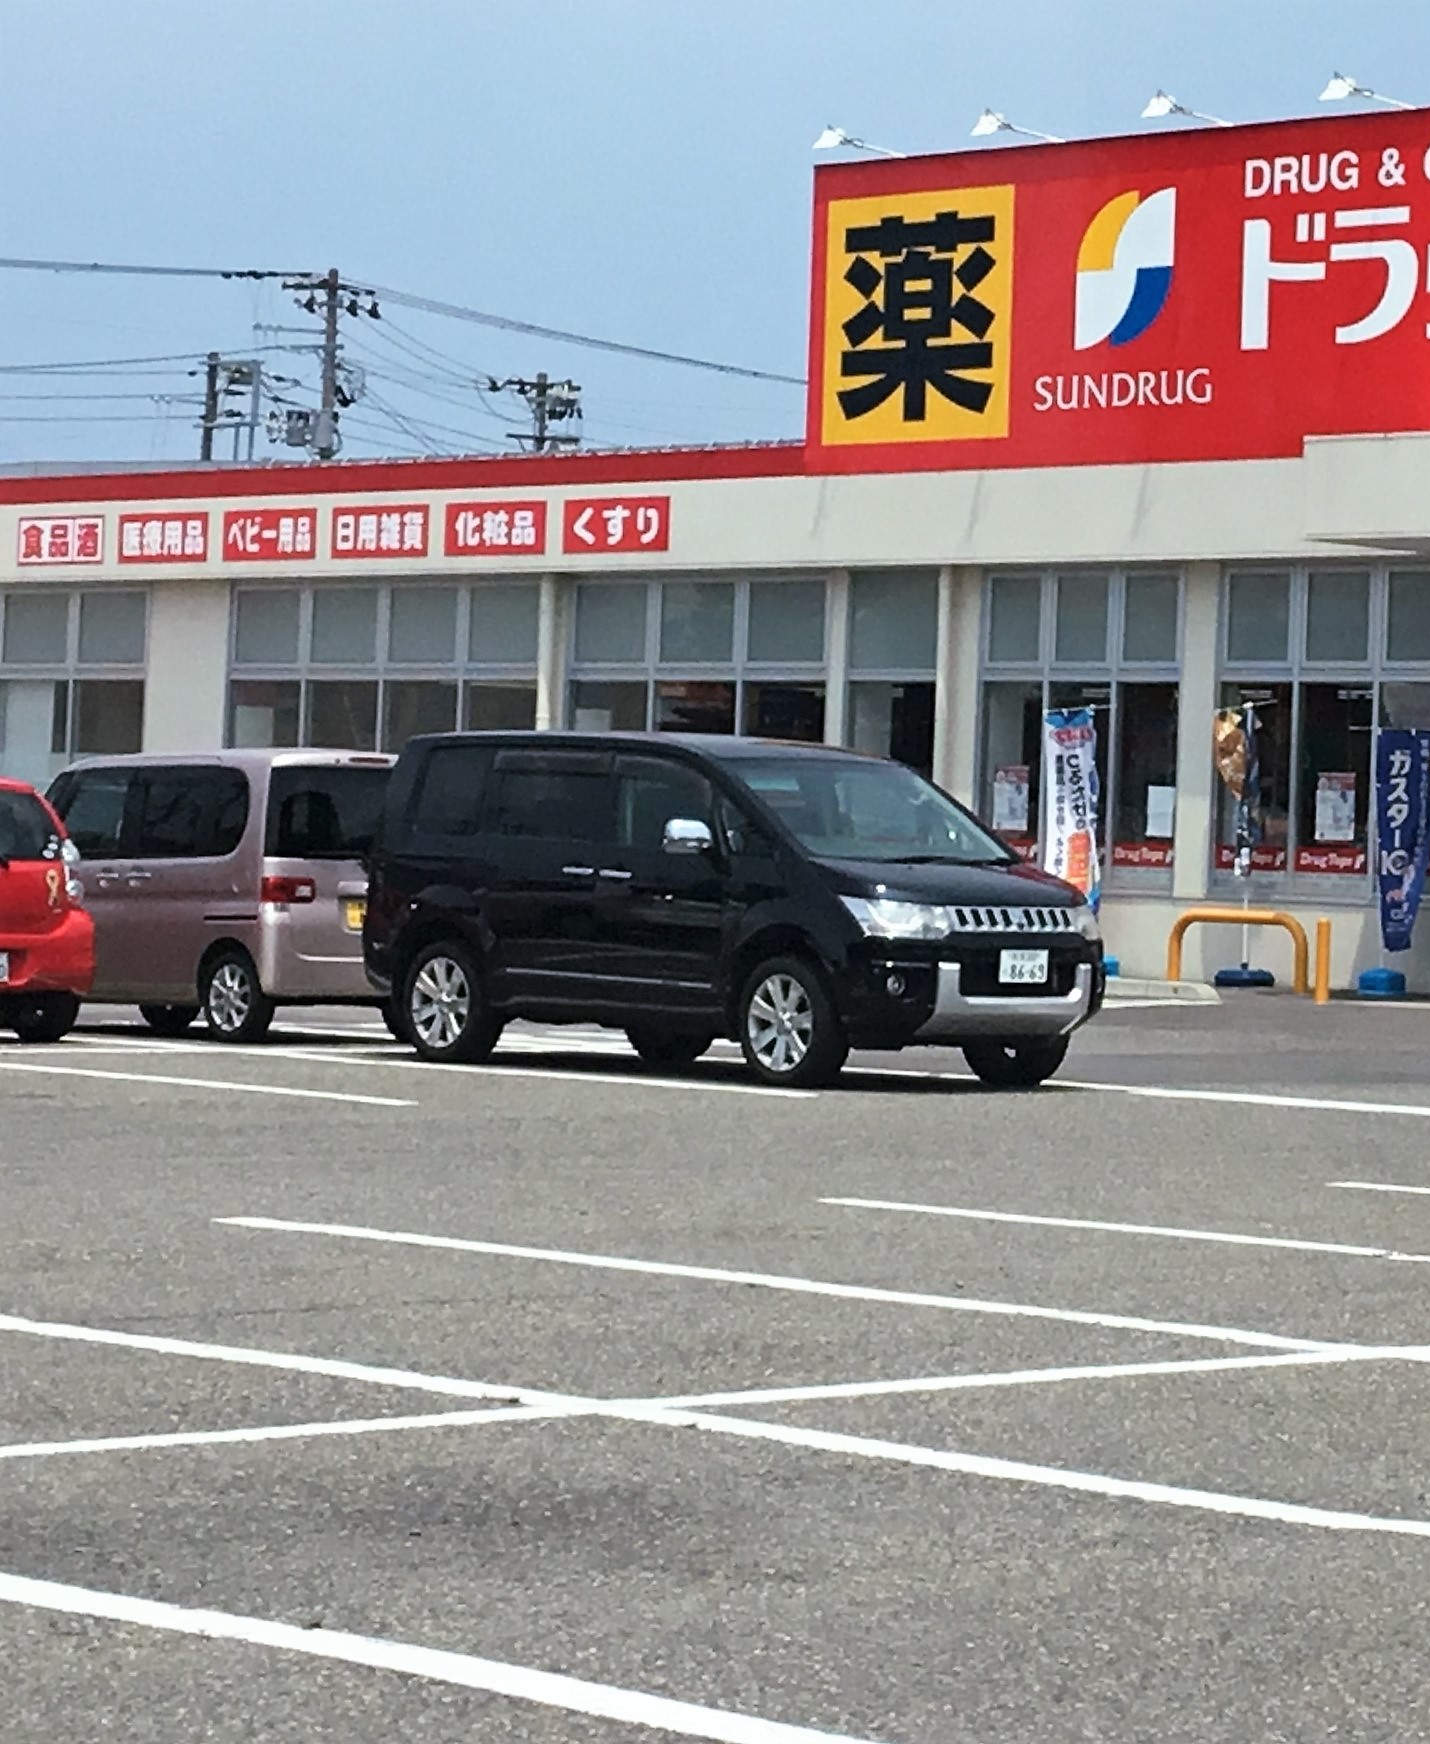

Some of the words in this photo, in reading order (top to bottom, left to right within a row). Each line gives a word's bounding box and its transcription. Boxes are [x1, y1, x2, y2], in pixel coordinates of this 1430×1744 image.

[1244, 151, 1359, 197] DRUG
[1377, 147, 1406, 187] &
[836, 210, 996, 422] 薬
[1033, 368, 1213, 411] SUNDRUG
[122, 519, 205, 557] 医療用品
[227, 516, 312, 554] ベビー用品
[336, 511, 425, 551] 日用雑貨
[454, 509, 536, 547] 化粧品
[573, 504, 659, 546] くすり
